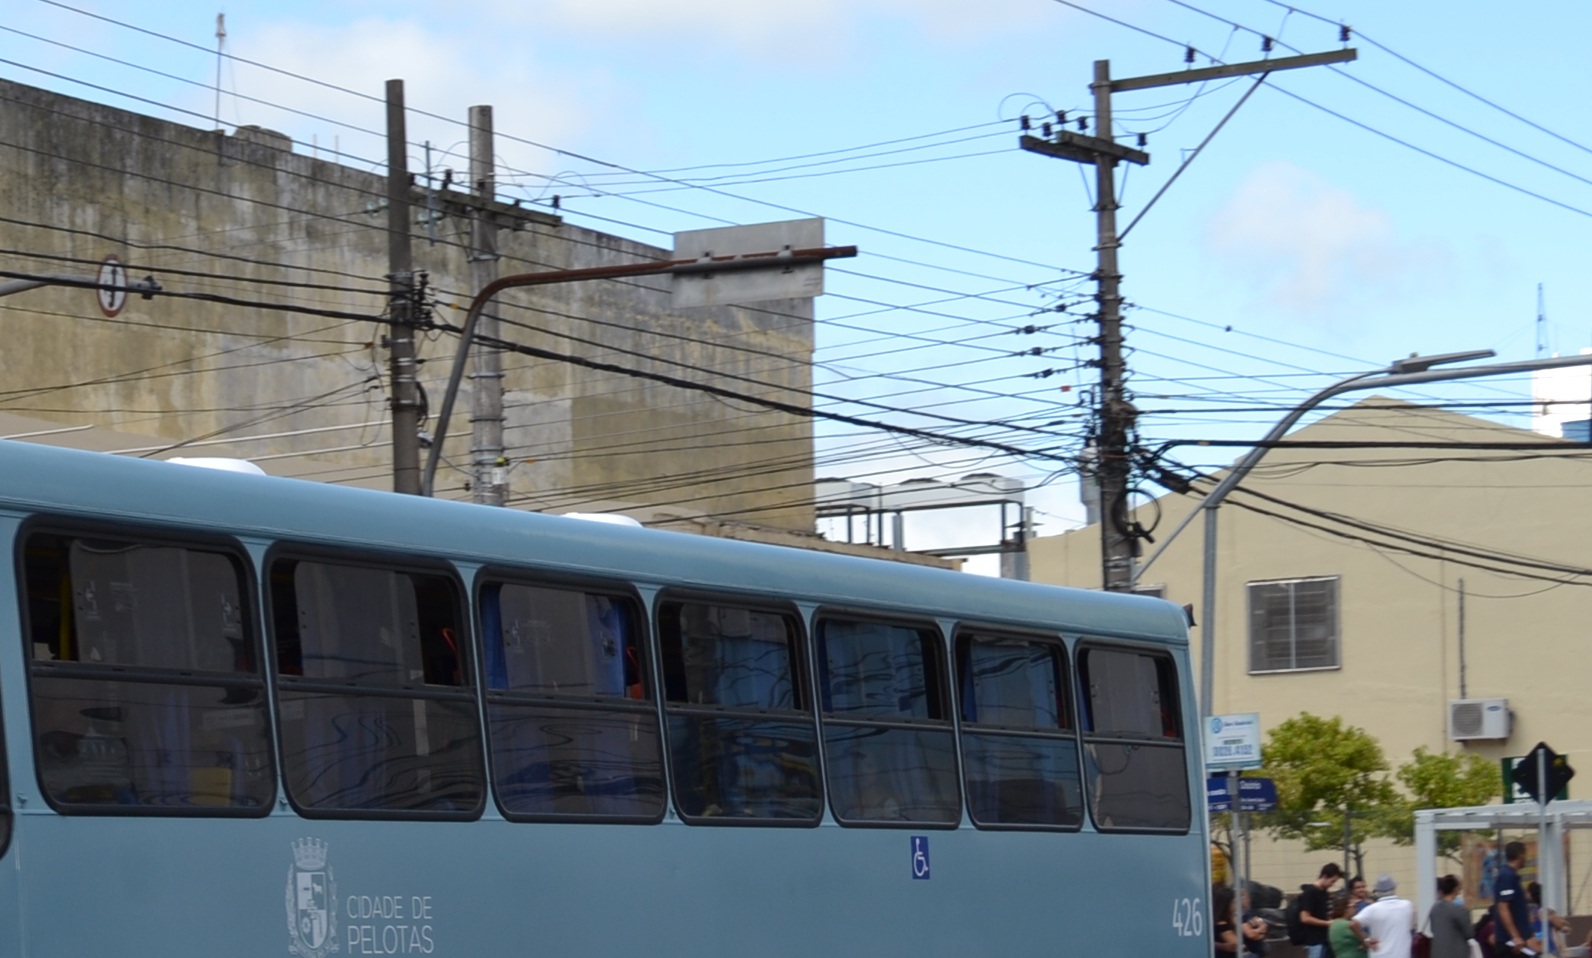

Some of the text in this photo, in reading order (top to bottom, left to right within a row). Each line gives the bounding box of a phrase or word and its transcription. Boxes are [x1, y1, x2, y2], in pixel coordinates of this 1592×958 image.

[347, 895, 433, 920] CIDADE DE
[1172, 897, 1203, 937] 426
[347, 924, 434, 955] PELOTAS
